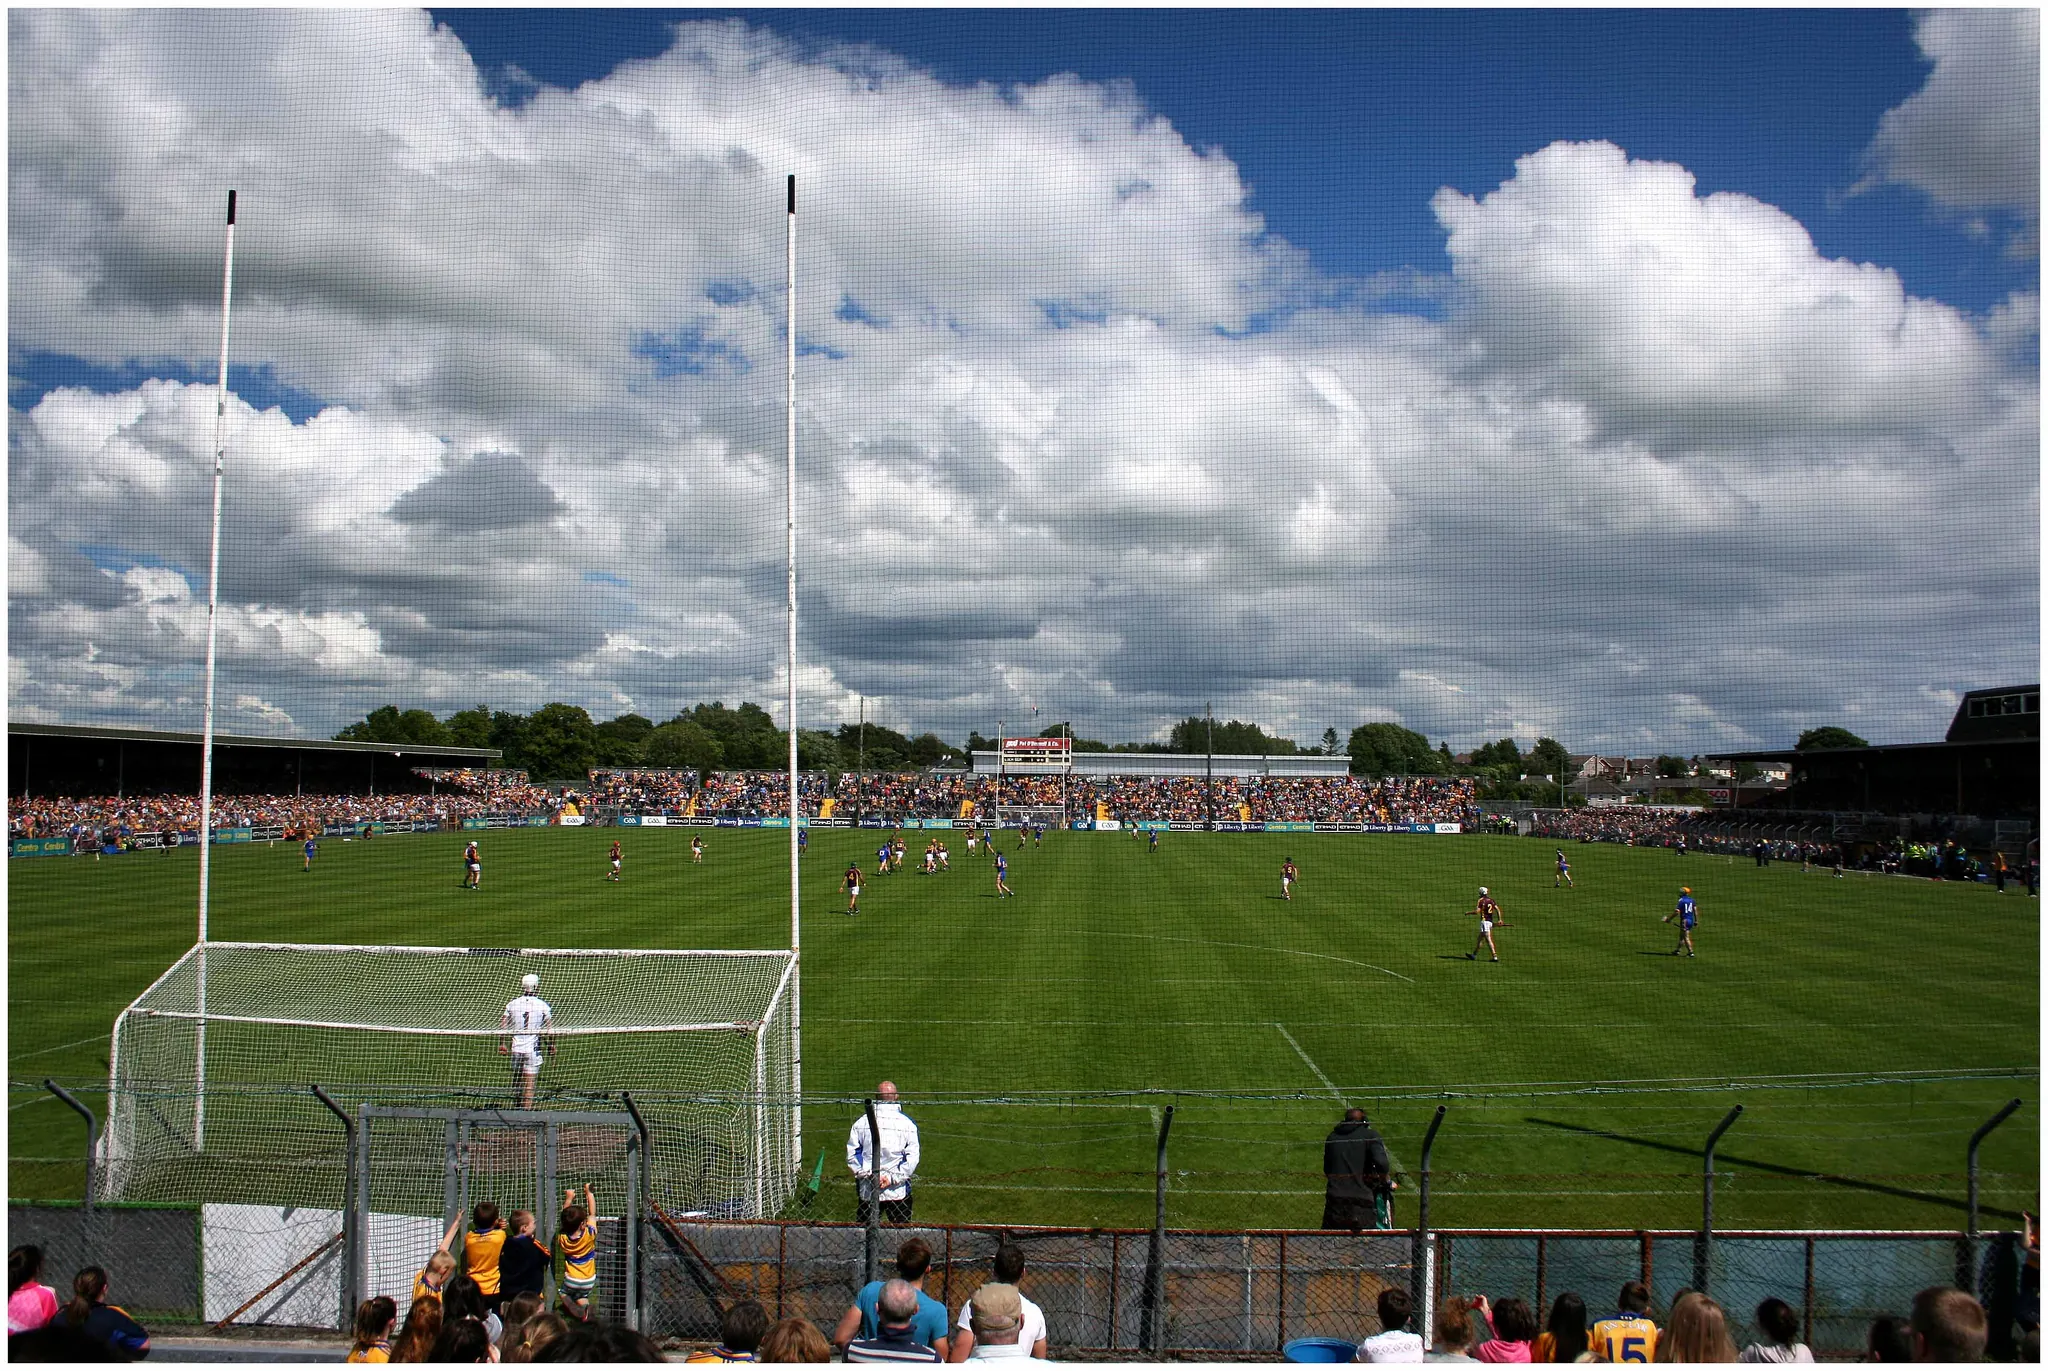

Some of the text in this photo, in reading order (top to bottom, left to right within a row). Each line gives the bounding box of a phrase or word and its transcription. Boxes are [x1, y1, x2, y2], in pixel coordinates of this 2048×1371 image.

[1488, 904, 1492, 913] 2
[1685, 903, 1692, 913] 14
[522, 1012, 529, 1028] 1
[1606, 1337, 1647, 1363] 15
